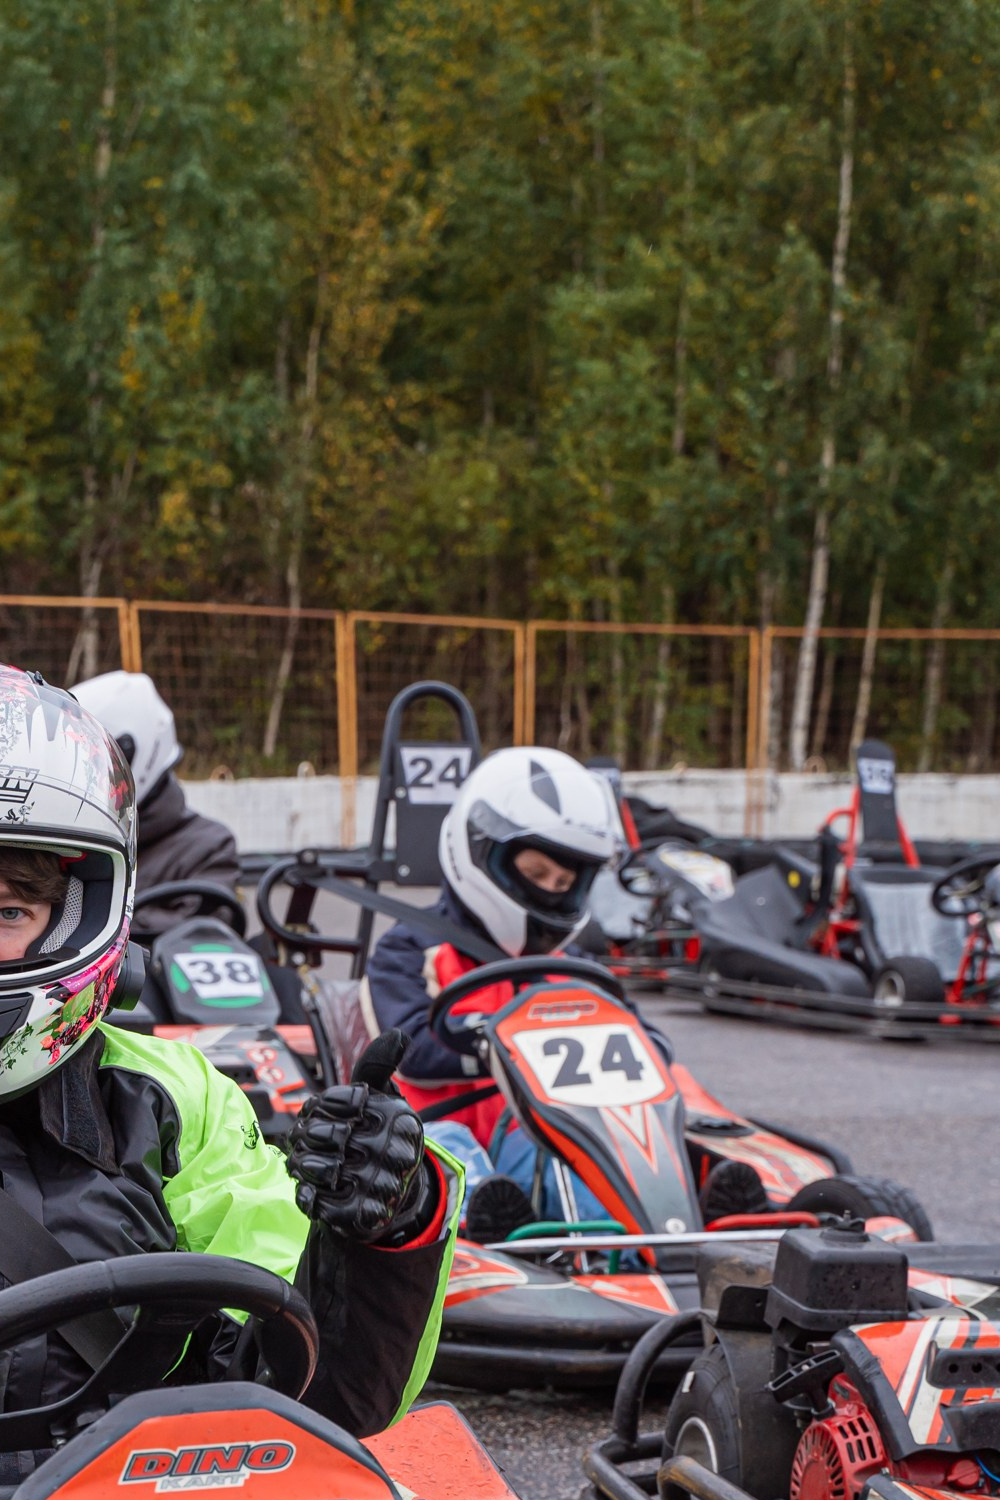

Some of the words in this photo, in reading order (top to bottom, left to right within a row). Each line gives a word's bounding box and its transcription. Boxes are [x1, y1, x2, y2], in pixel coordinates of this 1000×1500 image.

[408, 757, 466, 789] 24
[187, 960, 257, 984] 38
[542, 1033, 644, 1089] 24
[121, 1442, 295, 1482] DINO
[160, 1473, 246, 1490] KART
